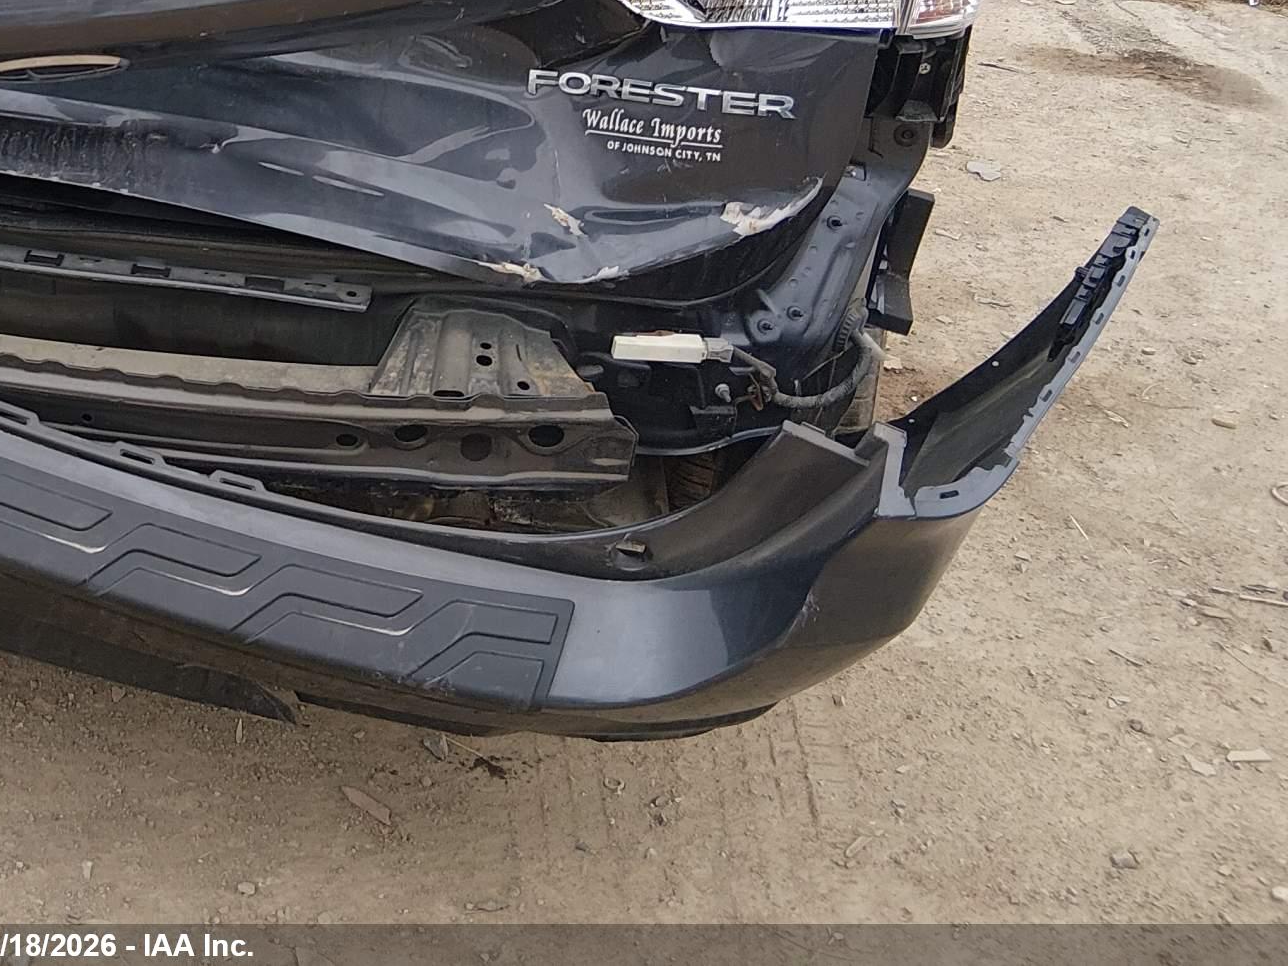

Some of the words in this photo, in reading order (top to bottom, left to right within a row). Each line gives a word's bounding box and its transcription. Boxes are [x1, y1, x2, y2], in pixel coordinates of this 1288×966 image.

[526, 69, 796, 119] FORESTER
[582, 108, 645, 135] Wallace
[650, 117, 722, 147] Imports
[607, 140, 620, 151] OF
[622, 142, 672, 158] JOHNSON
[705, 151, 722, 162] TN
